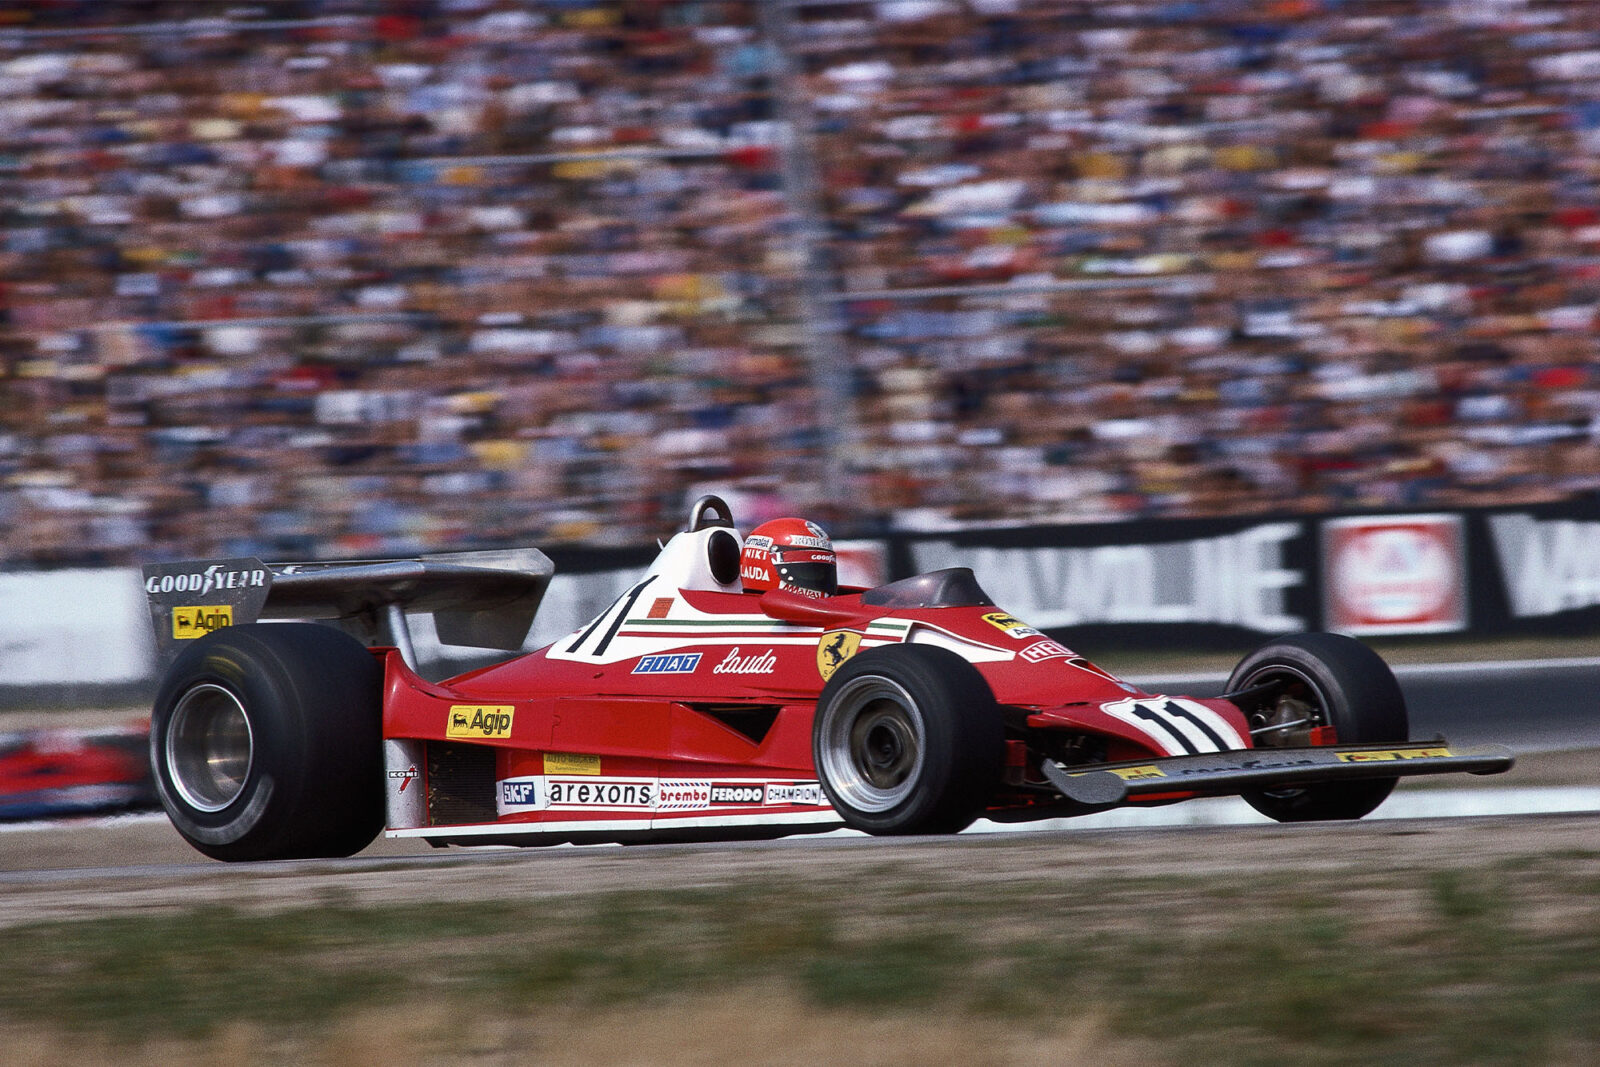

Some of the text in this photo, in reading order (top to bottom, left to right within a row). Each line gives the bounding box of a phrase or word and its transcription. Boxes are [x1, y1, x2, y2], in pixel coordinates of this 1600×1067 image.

[745, 549, 767, 560] NIKI
[146, 565, 264, 596] GOODYEAR
[740, 565, 770, 581] LAUDA
[195, 609, 230, 632] Agip
[565, 575, 660, 656] 11
[638, 655, 699, 673] FIAT
[713, 647, 777, 674] Lauda
[470, 709, 512, 735] Agip
[1131, 701, 1232, 756] 11
[503, 783, 533, 803] SKF
[550, 784, 651, 804] arexons
[660, 790, 708, 801] brembo
[711, 788, 763, 802] FERODO
[767, 788, 818, 800] CHAMPION
